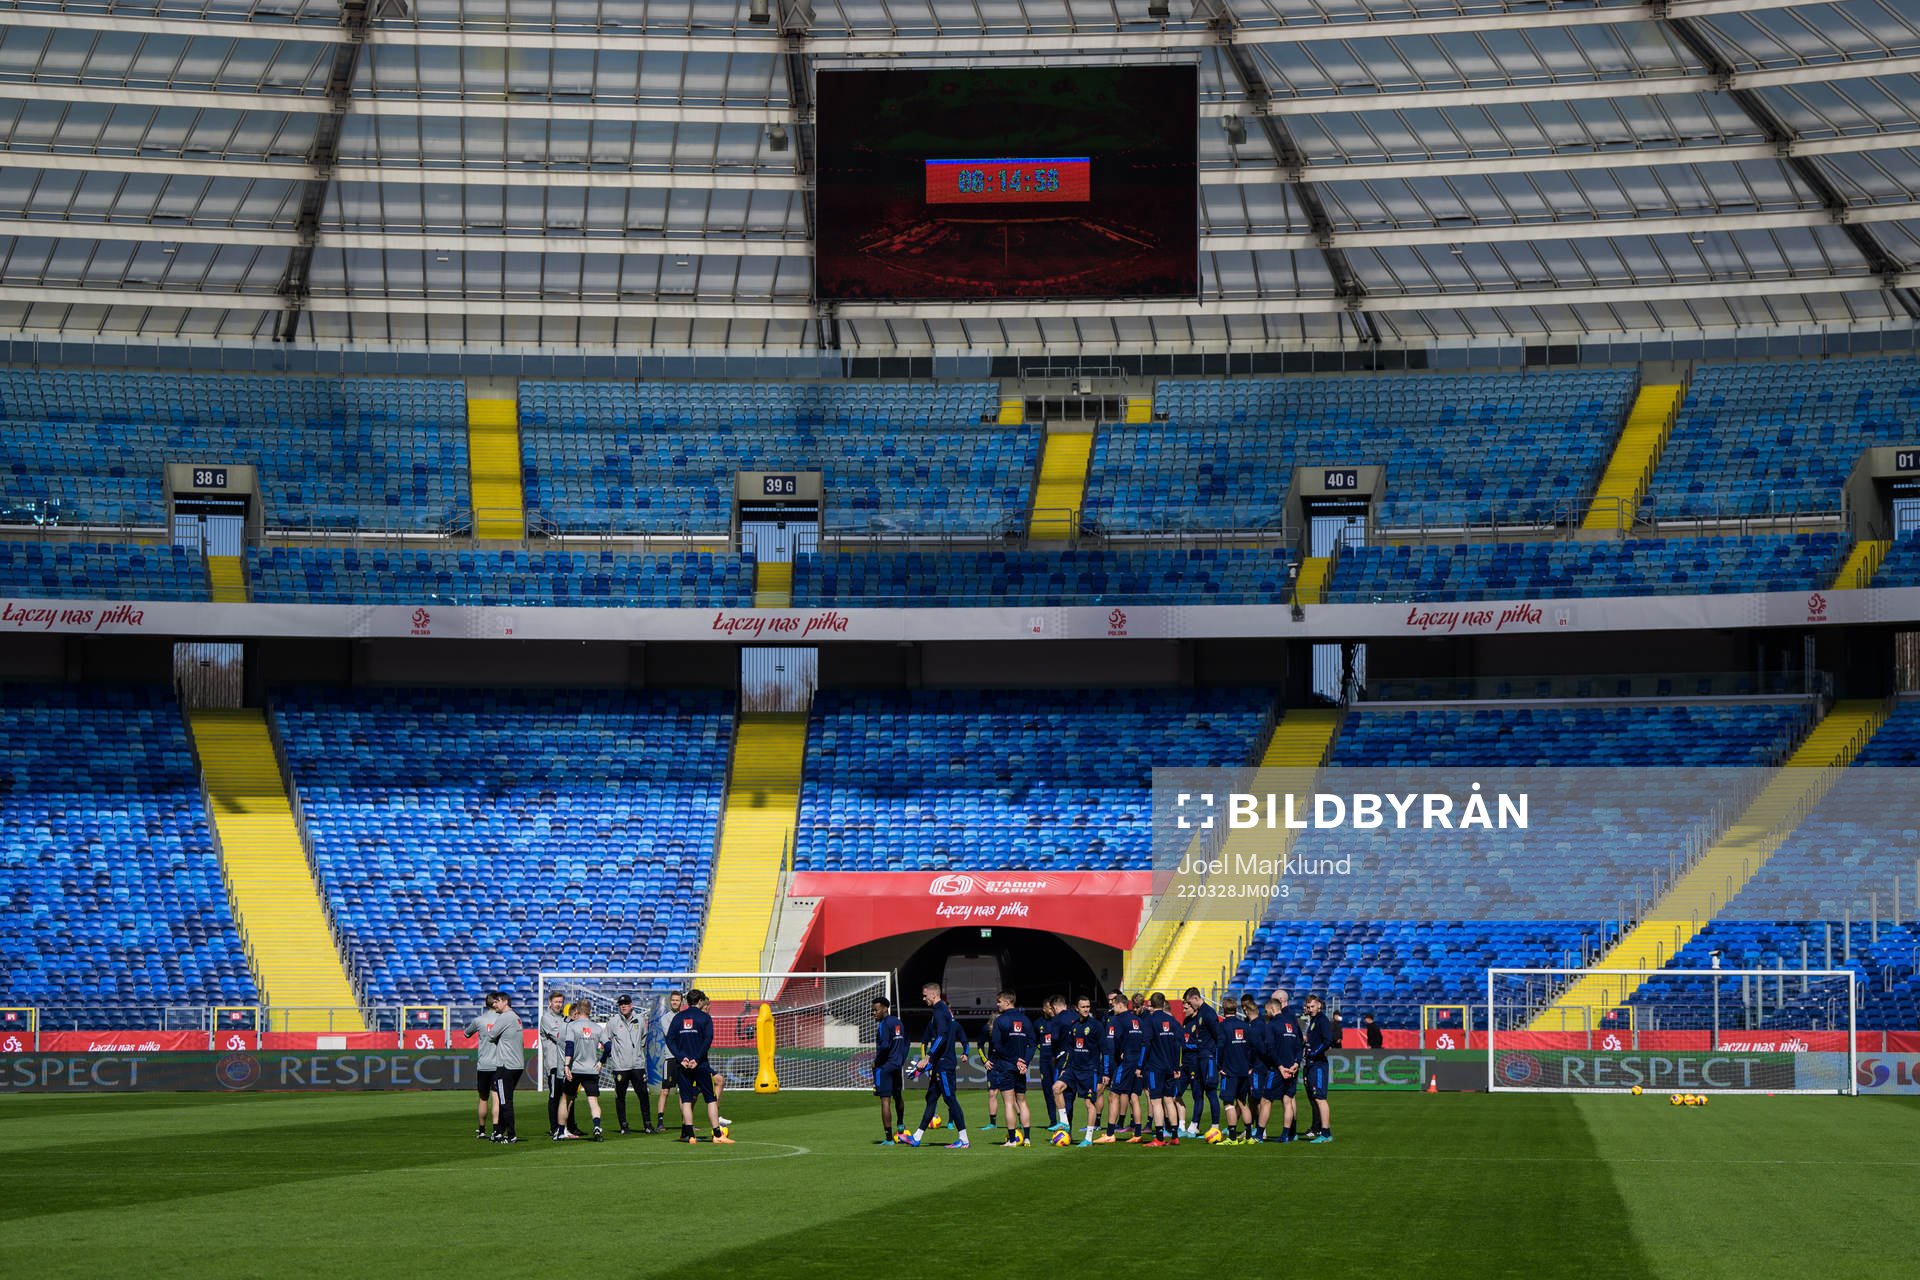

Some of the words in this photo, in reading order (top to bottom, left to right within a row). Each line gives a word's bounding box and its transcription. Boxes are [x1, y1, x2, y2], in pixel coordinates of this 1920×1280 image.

[1899, 453, 1914, 468] 01
[196, 471, 213, 485] 38
[216, 474, 224, 485] G
[766, 478, 782, 492] 39
[786, 481, 793, 492] G
[1328, 473, 1343, 487] 40
[1347, 475, 1355, 486] G
[2, 602, 58, 630] Łączy
[60, 609, 94, 625] nas
[94, 604, 144, 631] piłka
[712, 612, 766, 638] Łączy
[768, 616, 800, 632] nas
[801, 611, 849, 638] piłka
[1406, 607, 1460, 633] Łączy
[1461, 610, 1494, 626] nas
[1496, 603, 1543, 631] piłka
[936, 901, 973, 920] Łączy
[974, 905, 996, 916] nas
[996, 902, 1029, 920] piłka
[1718, 1042, 1751, 1052] ączy
[280, 1055, 469, 1085] RESPECT
[1562, 1056, 1760, 1087] RESPECT
